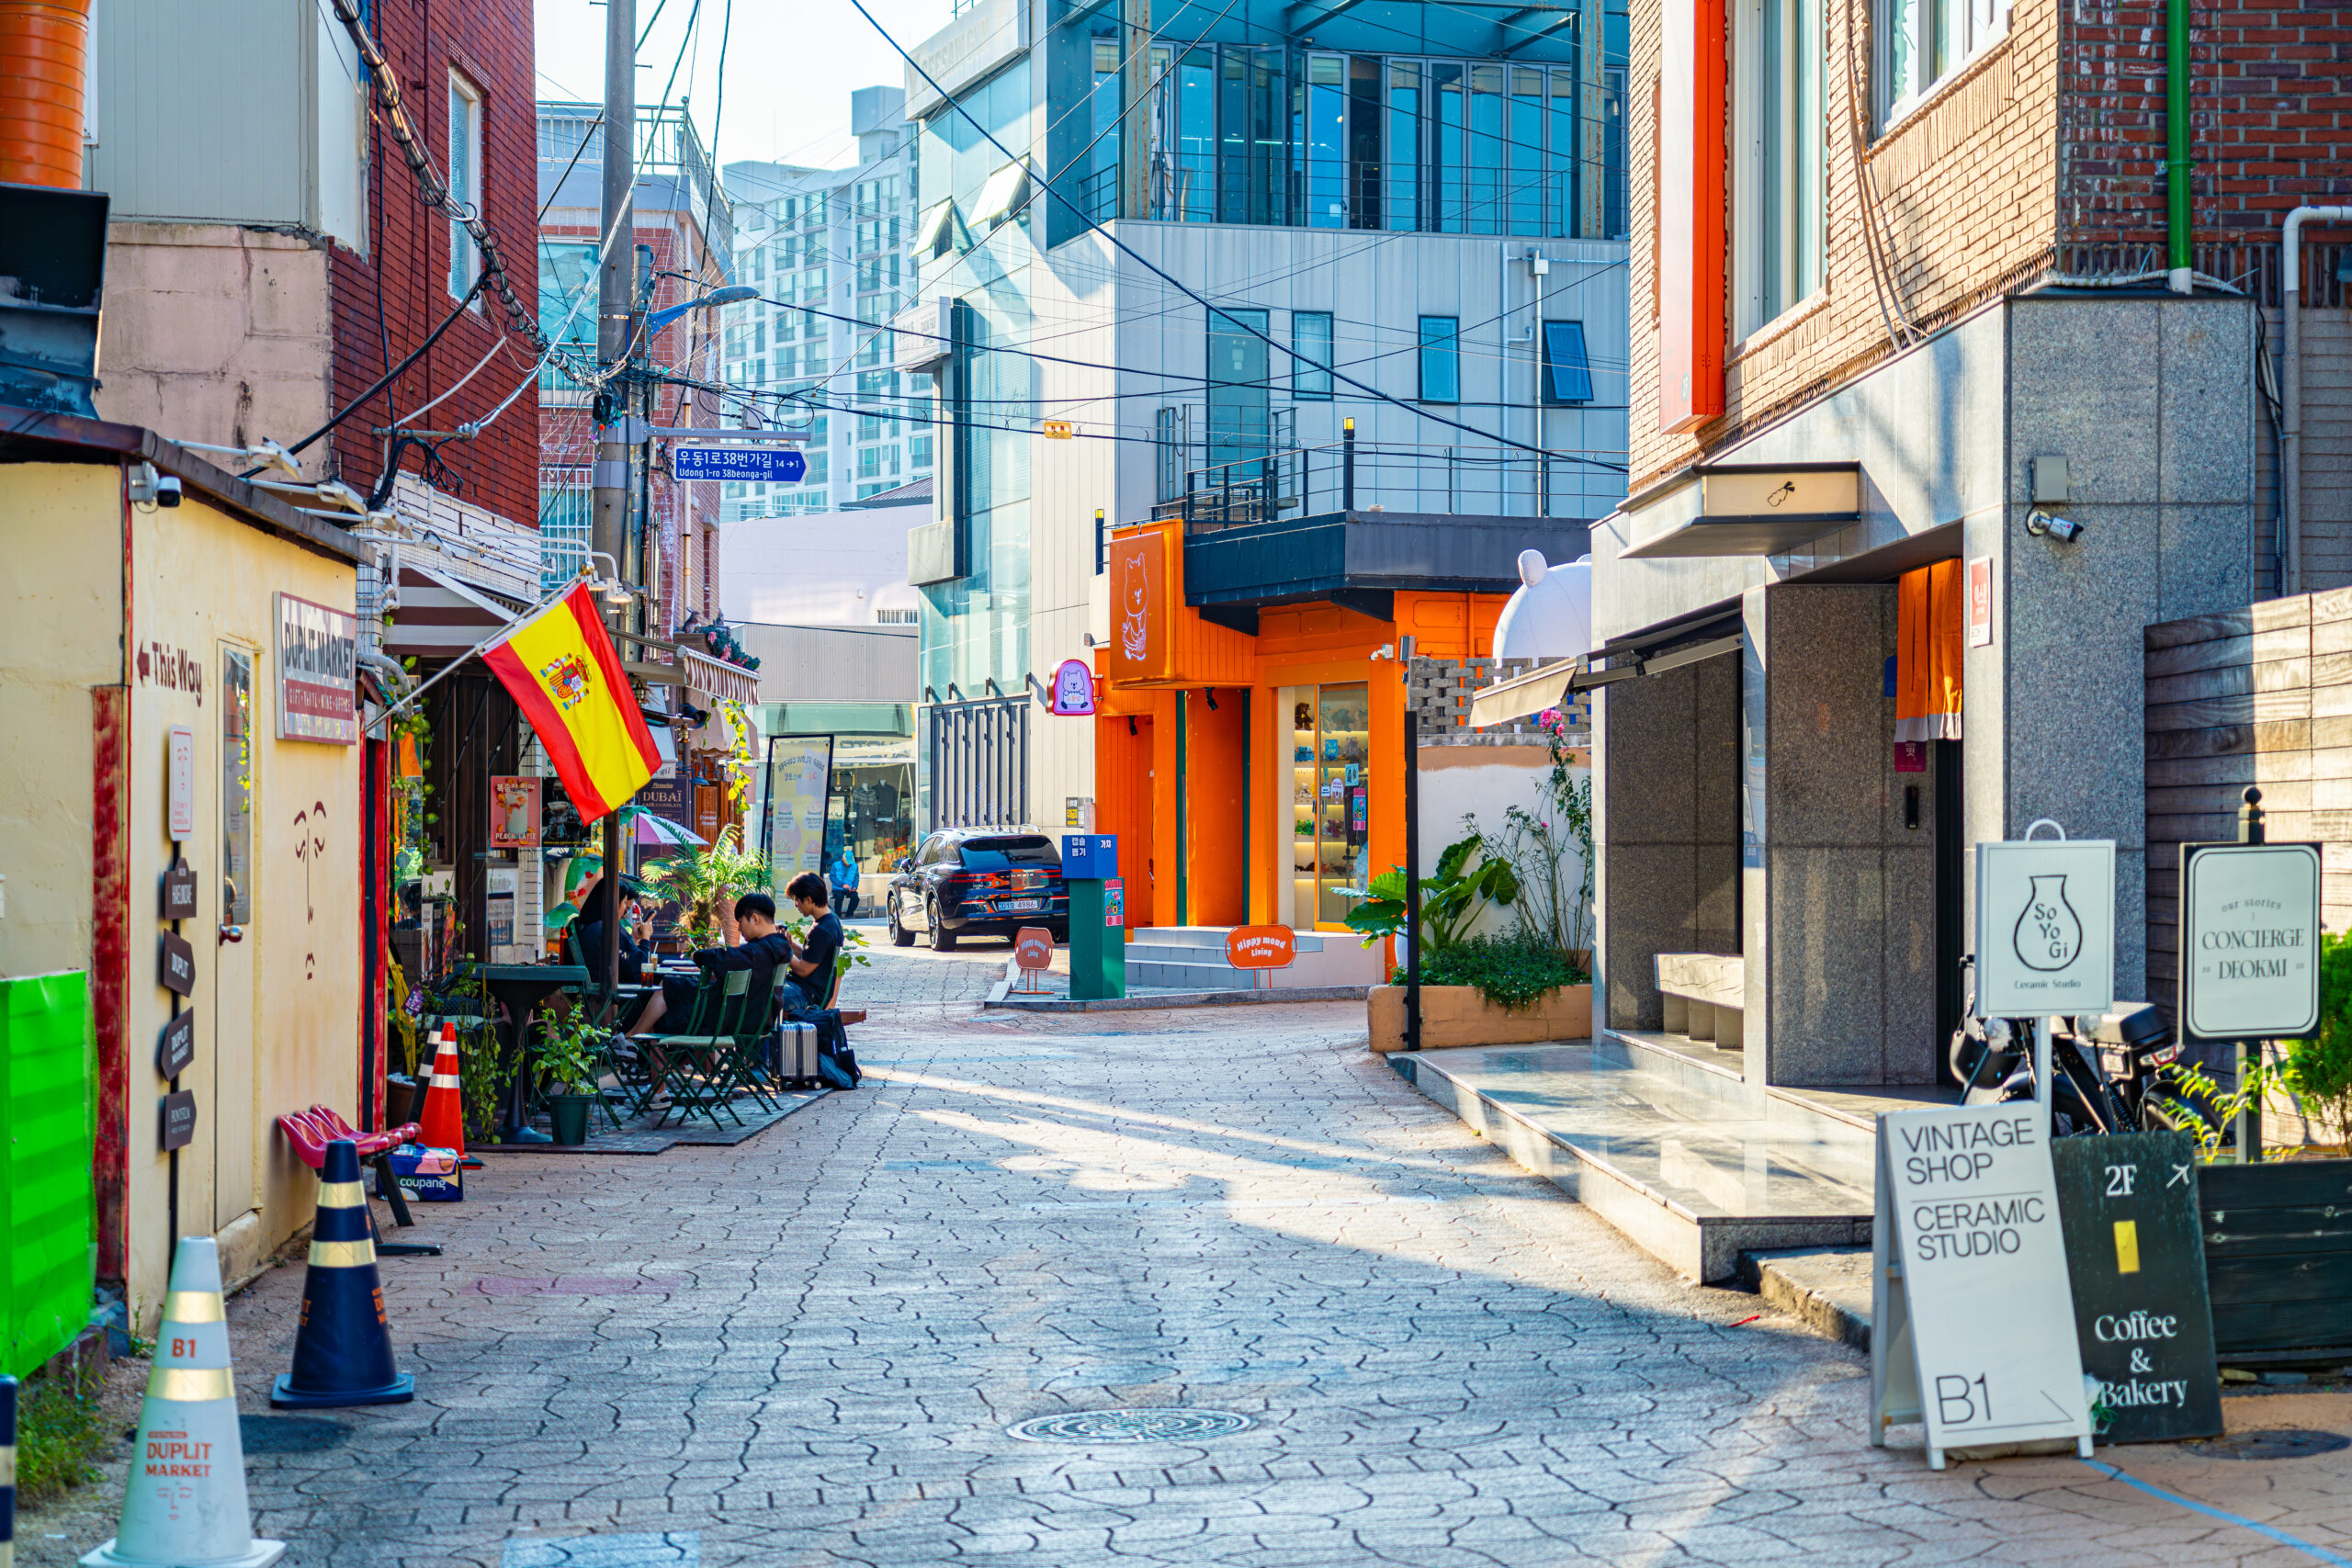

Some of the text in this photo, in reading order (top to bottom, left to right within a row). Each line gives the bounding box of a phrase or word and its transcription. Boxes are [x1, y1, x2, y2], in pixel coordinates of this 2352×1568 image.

[679, 451, 772, 468] 우동1로38번가길
[775, 460, 785, 468] 14
[680, 468, 704, 479] Udong
[722, 469, 773, 479] 38beonga-gil
[285, 622, 355, 680] DUPLIT MARKET
[152, 641, 202, 708] This Way
[643, 790, 683, 802] DUBAÏ
[1101, 839, 1111, 849] 가차
[2034, 903, 2057, 920] So
[2222, 898, 2282, 912] our stories
[2039, 922, 2061, 939] Yo
[2202, 928, 2304, 950] CONCIERGE
[1237, 937, 1286, 952] Hippy mond
[1251, 948, 1272, 957] Living
[2049, 941, 2068, 958] Gi
[2218, 958, 2287, 979] DEOKMI
[2014, 978, 2082, 989] Ceramic Studio
[1901, 1118, 2035, 1153] VINTAGE
[1906, 1153, 1993, 1185] SHOP
[400, 1178, 447, 1191] coupang
[2105, 1164, 2138, 1197] 2F
[1914, 1198, 2045, 1232] CERAMIC
[1917, 1228, 2021, 1261] STUDIO
[2095, 1309, 2177, 1342] Coffee
[172, 1337, 197, 1359] B1
[2131, 1348, 2154, 1373] &
[1936, 1372, 1992, 1425] B1
[2098, 1378, 2188, 1409] Bakery
[147, 1443, 213, 1461] DUPLIT
[145, 1464, 211, 1477] MARKET
